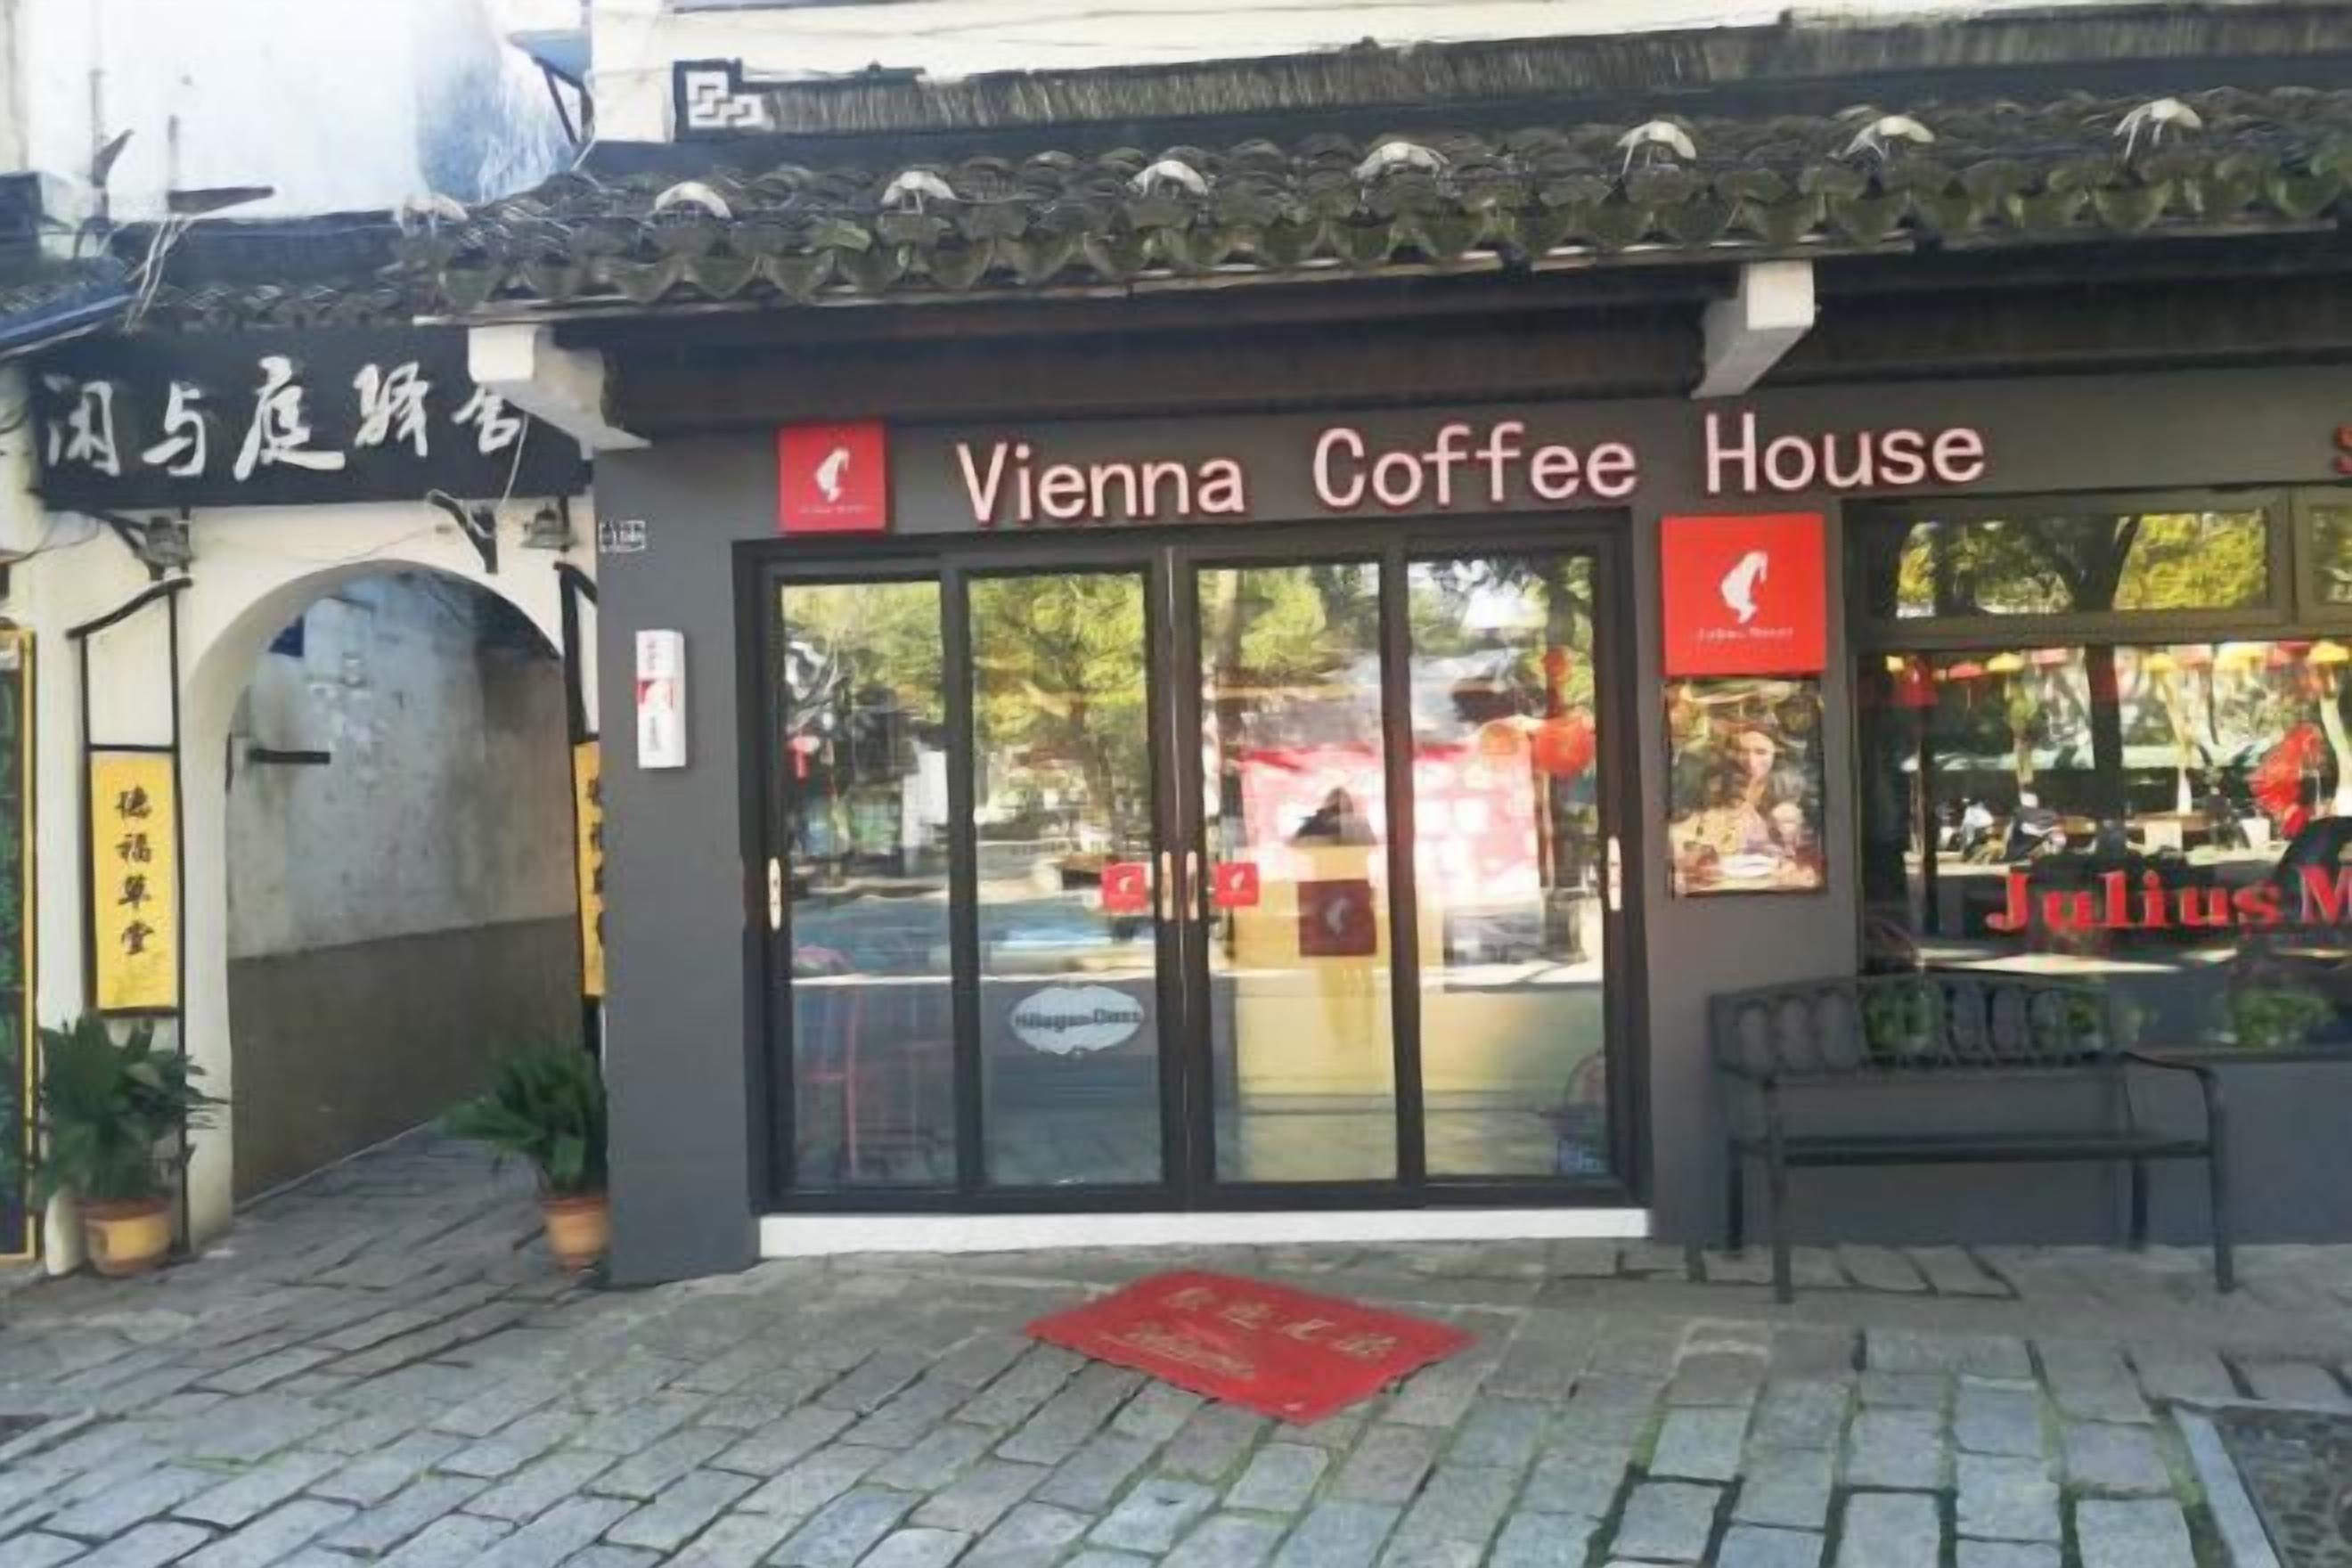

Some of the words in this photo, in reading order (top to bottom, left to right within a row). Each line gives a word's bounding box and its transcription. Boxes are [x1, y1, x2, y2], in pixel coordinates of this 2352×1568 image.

[956, 442, 1245, 523] Vienna
[1313, 421, 1637, 509] Coffee
[1705, 412, 1985, 494] House
[1985, 870, 2283, 930] Julius
